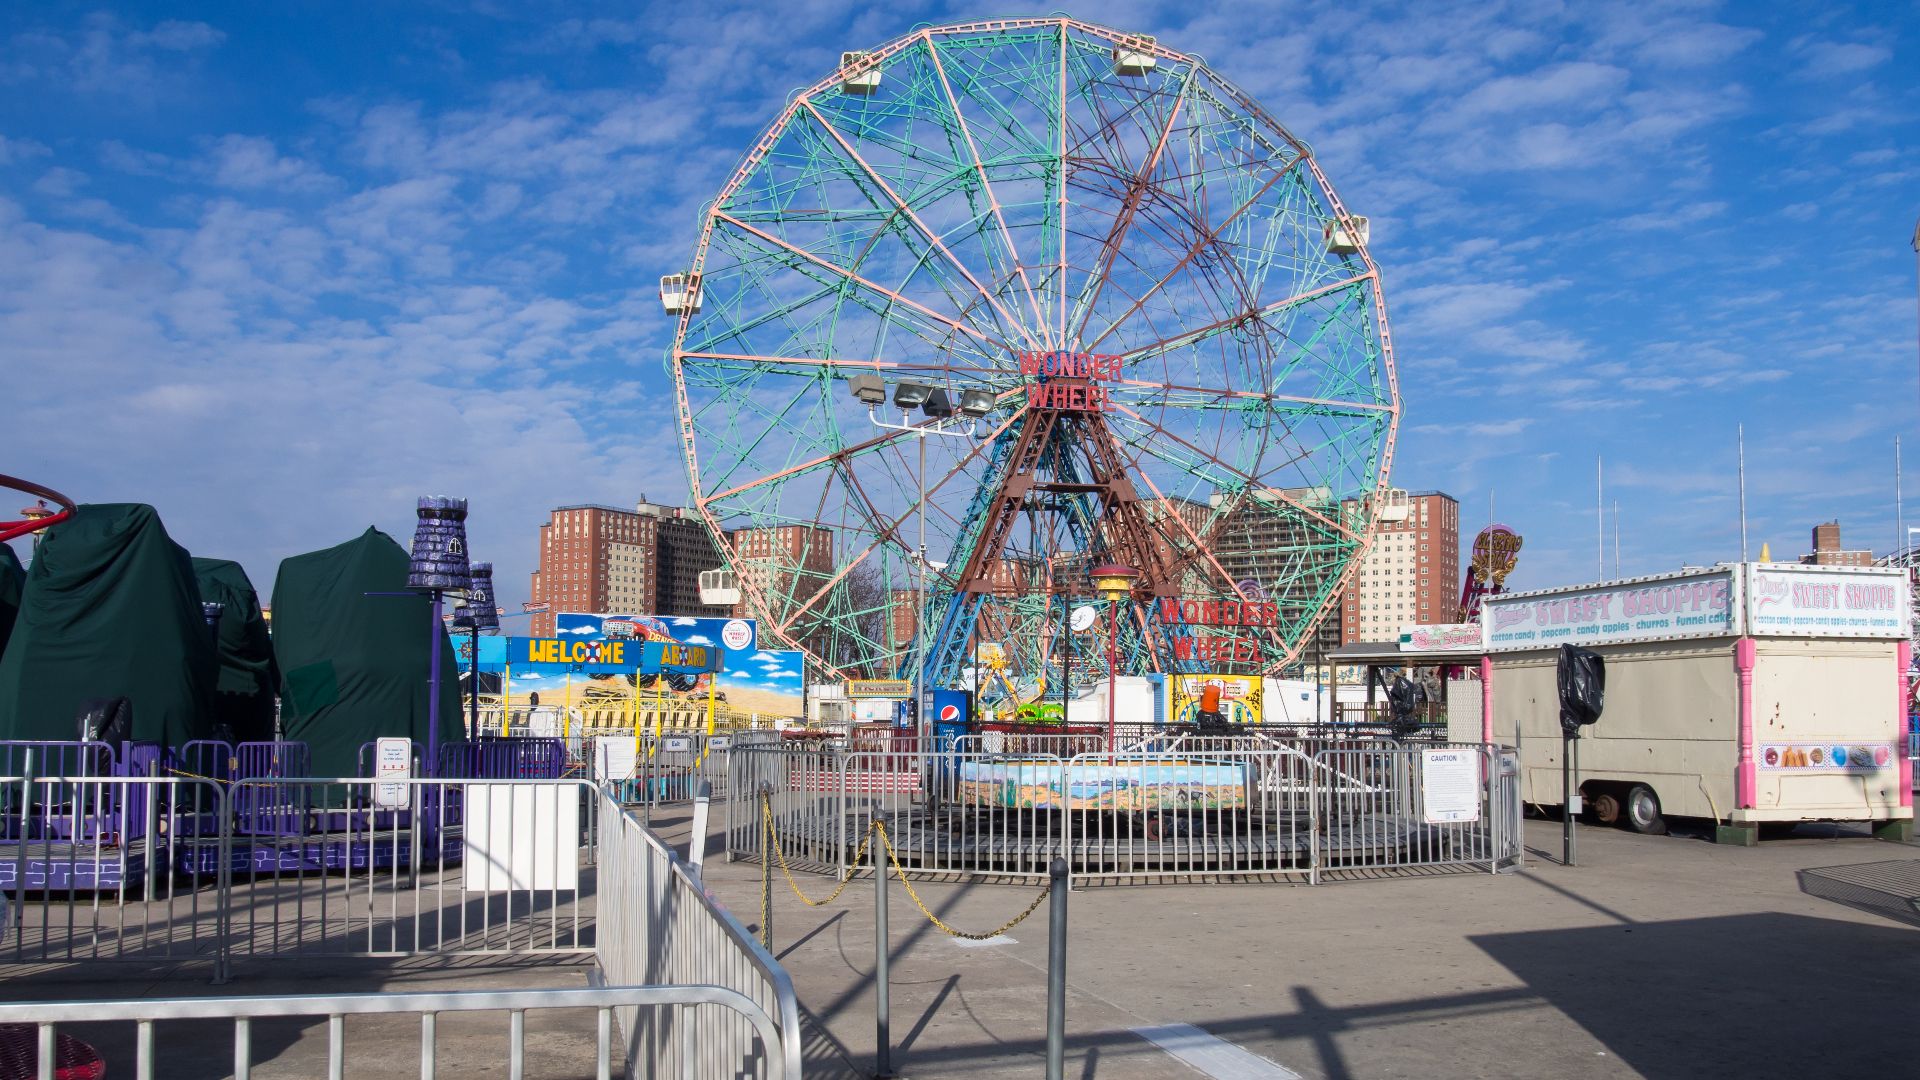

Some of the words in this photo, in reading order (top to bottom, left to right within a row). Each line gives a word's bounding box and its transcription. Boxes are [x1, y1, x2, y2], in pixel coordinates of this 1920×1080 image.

[1019, 350, 1123, 383] WONDER
[1028, 383, 1117, 412] WHEEL
[1536, 593, 1613, 626] SWEET
[1622, 579, 1728, 618] SHOPPE
[1792, 581, 1840, 609] SWEET
[1845, 583, 1896, 611] SHOPPE
[1160, 598, 1279, 627] WONDER
[1491, 631, 1514, 642] cotton
[1514, 629, 1536, 641] candy
[1541, 628, 1571, 639] popcorn
[1576, 624, 1600, 636] candy
[1602, 622, 1630, 634] apples
[1636, 618, 1669, 630] churros
[1676, 614, 1706, 626] funnel
[1708, 612, 1732, 624] cake
[528, 639, 624, 664] WELCOME
[660, 644, 707, 667] ABOARD
[1173, 636, 1265, 663] WHEEL
